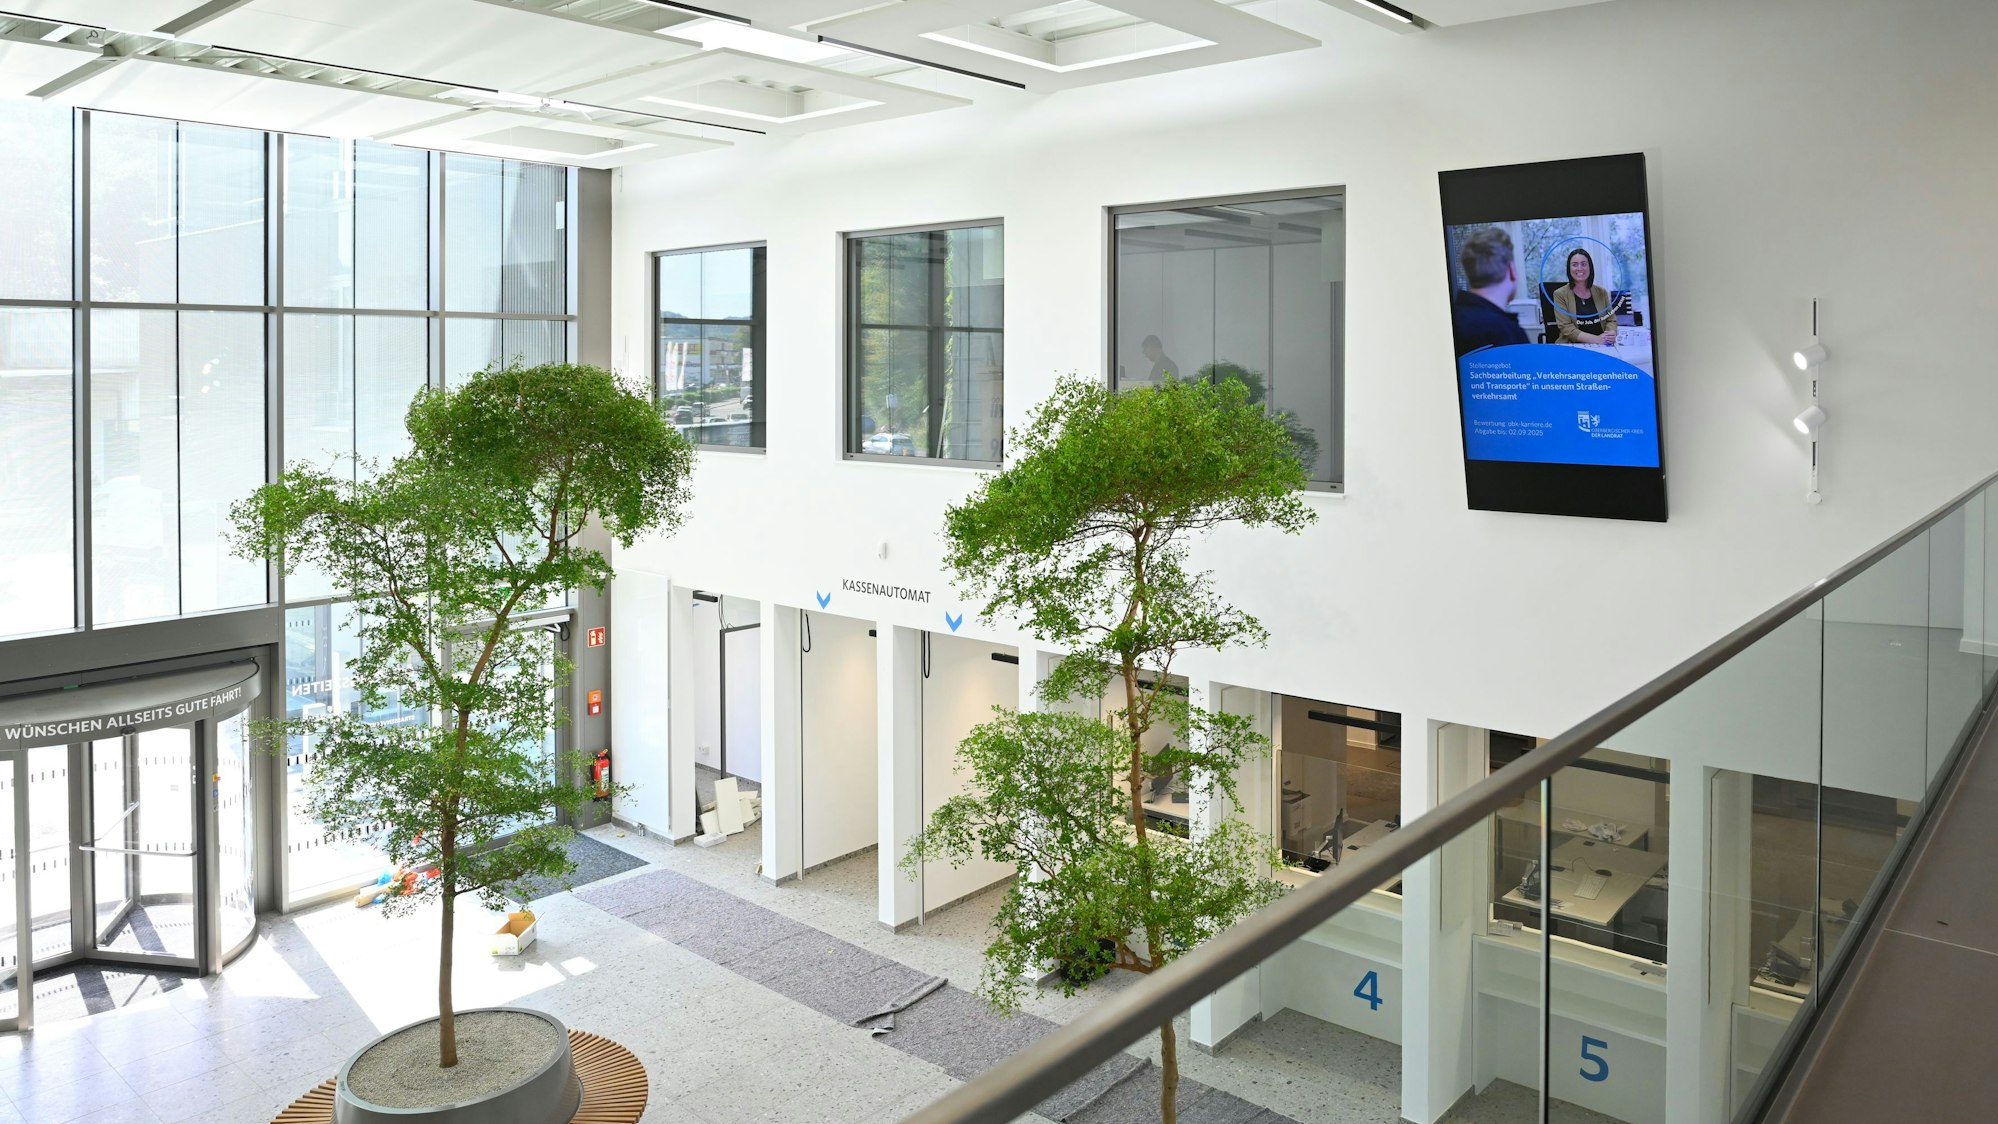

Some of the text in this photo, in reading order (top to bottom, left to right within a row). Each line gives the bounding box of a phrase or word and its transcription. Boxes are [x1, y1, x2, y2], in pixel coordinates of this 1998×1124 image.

[1469, 362, 1511, 370] Stellenangebot
[1470, 371, 1638, 381] Sachbearbeitung „Verkehrsangelegenheiten
[1486, 382, 1530, 390] Transporte“
[1576, 382, 1611, 391] Straßen-
[1472, 392, 1517, 400] verkehrsamt
[1508, 420, 1552, 428] obk-karriere.de
[1474, 428, 1496, 436] Abgabe
[842, 578, 931, 603] KASSENAUTOMAT
[5, 686, 242, 740] WÜNSCHEN ALLSEITS GUTE FAHRT!
[1353, 970, 1383, 1011] 4
[1579, 1035, 1609, 1082] 5
